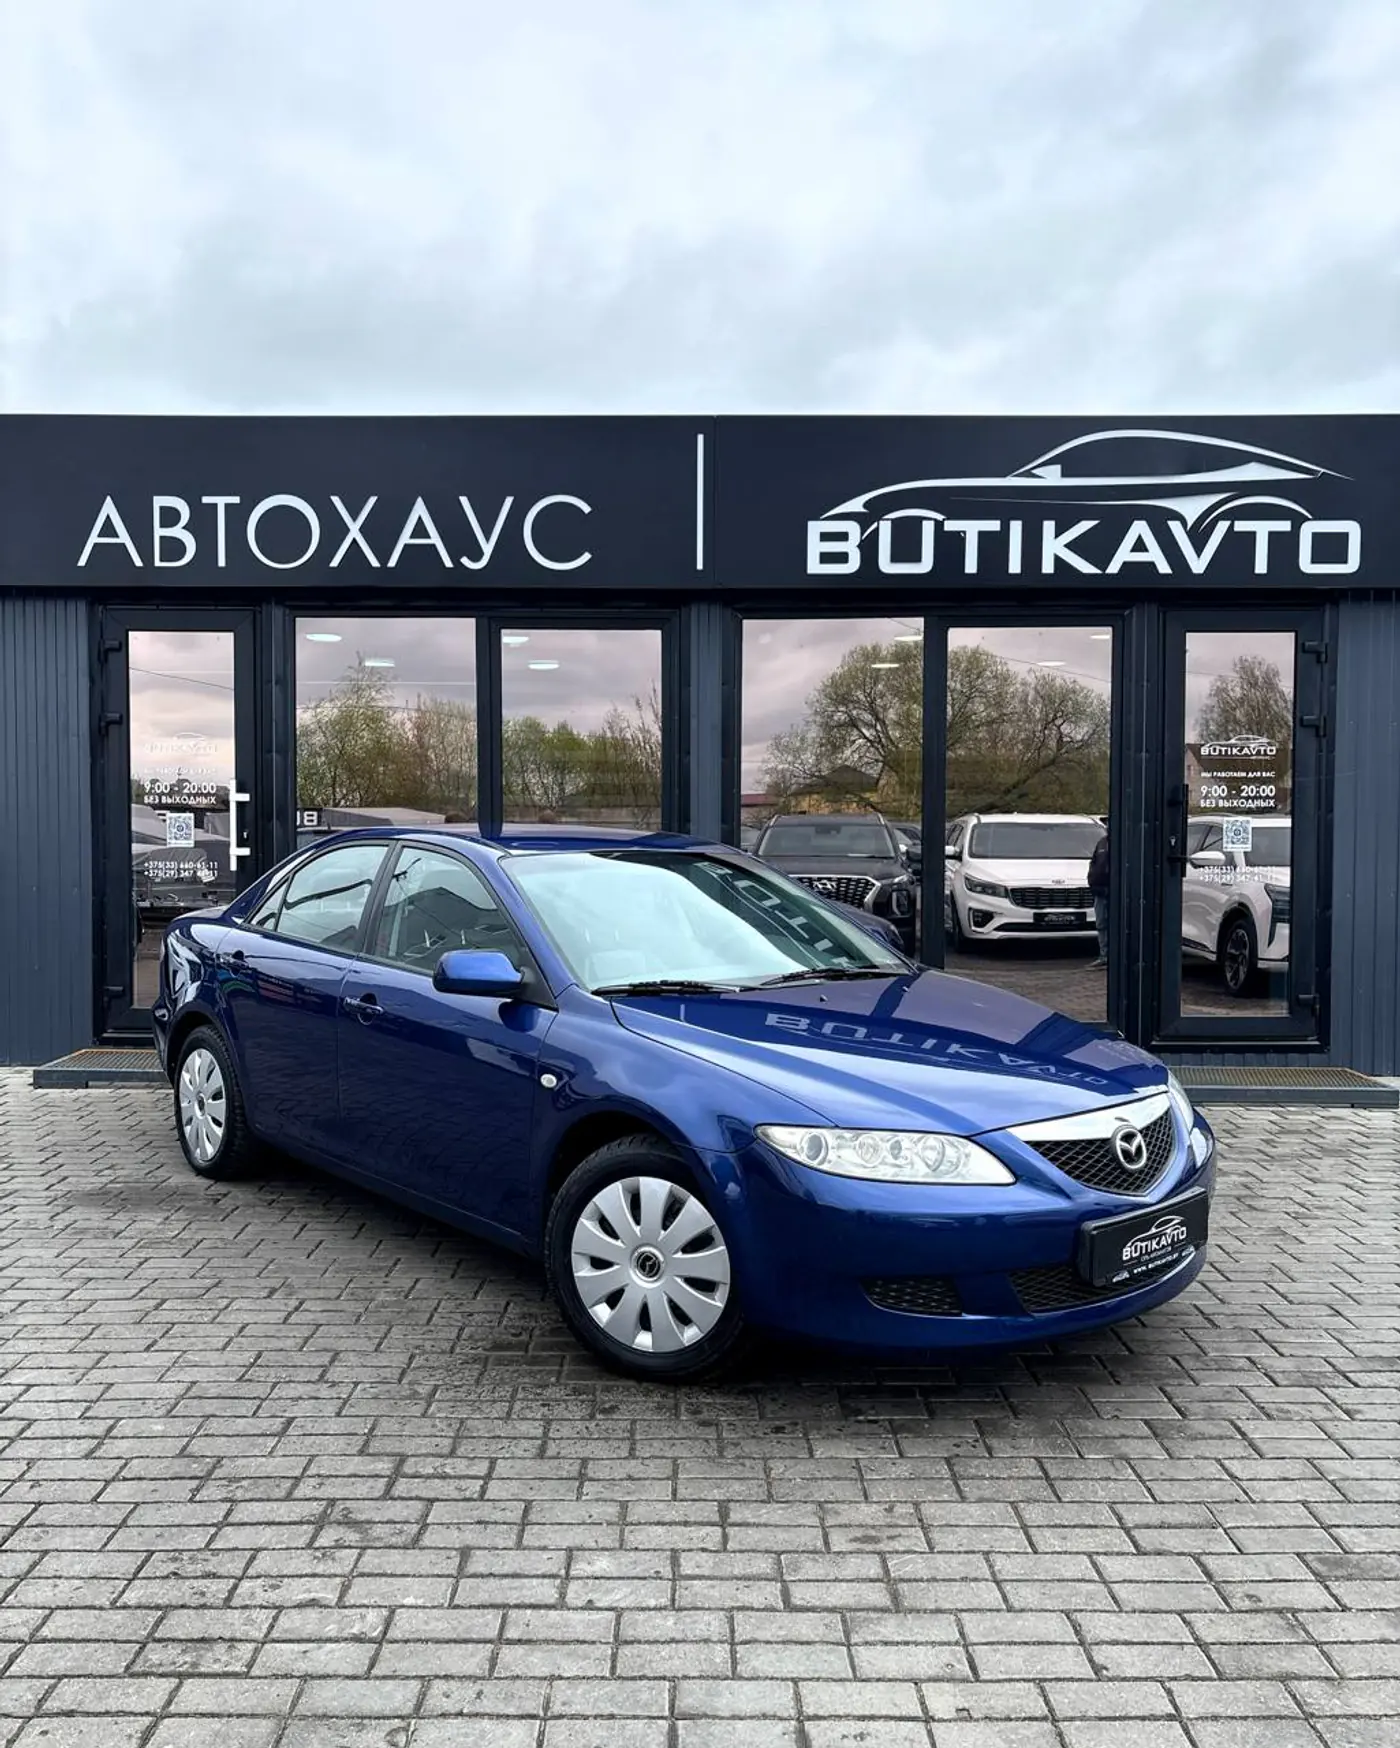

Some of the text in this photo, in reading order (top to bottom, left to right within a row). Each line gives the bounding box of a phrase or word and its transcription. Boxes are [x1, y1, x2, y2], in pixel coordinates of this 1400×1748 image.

[76, 494, 592, 571] АВТОХАУС
[806, 519, 1361, 574] BUTIKAVTO
[1200, 747, 1276, 755] BUTIKAVTO
[144, 782, 170, 794] 9:00
[183, 782, 217, 794] 20:00
[1200, 785, 1228, 797] 9:00
[1240, 785, 1276, 797] 20:00
[144, 795, 217, 805] БЕЗ ВЫХОДНЫХ
[1200, 799, 1276, 808] БЕЗ ВЫХОДНЫХ
[1122, 1226, 1187, 1261] BUTIKAVTO
